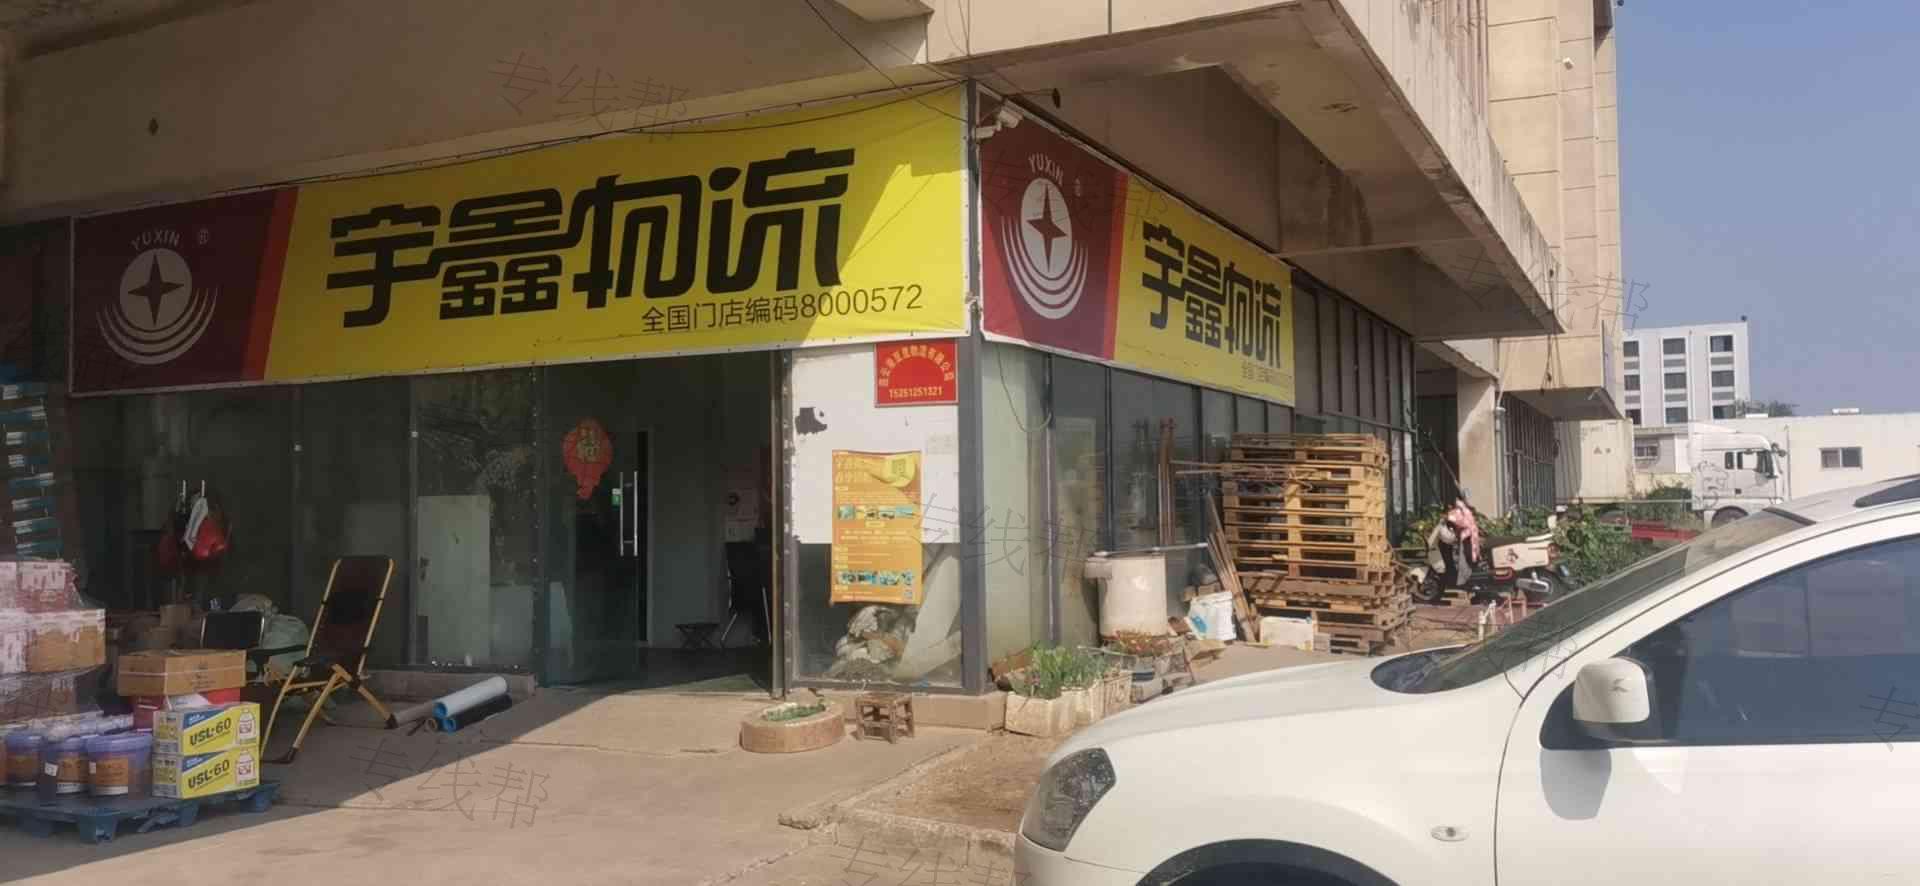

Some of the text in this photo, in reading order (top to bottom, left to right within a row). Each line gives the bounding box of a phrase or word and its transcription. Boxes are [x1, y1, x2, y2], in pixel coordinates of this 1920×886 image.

[1028, 152, 1064, 186] YUXIN
[131, 229, 180, 251] YUXIN
[326, 147, 855, 329] 宇鑫物流
[641, 284, 923, 333] 全国门店编码8000572
[1141, 220, 1281, 368] 宇鑫物流
